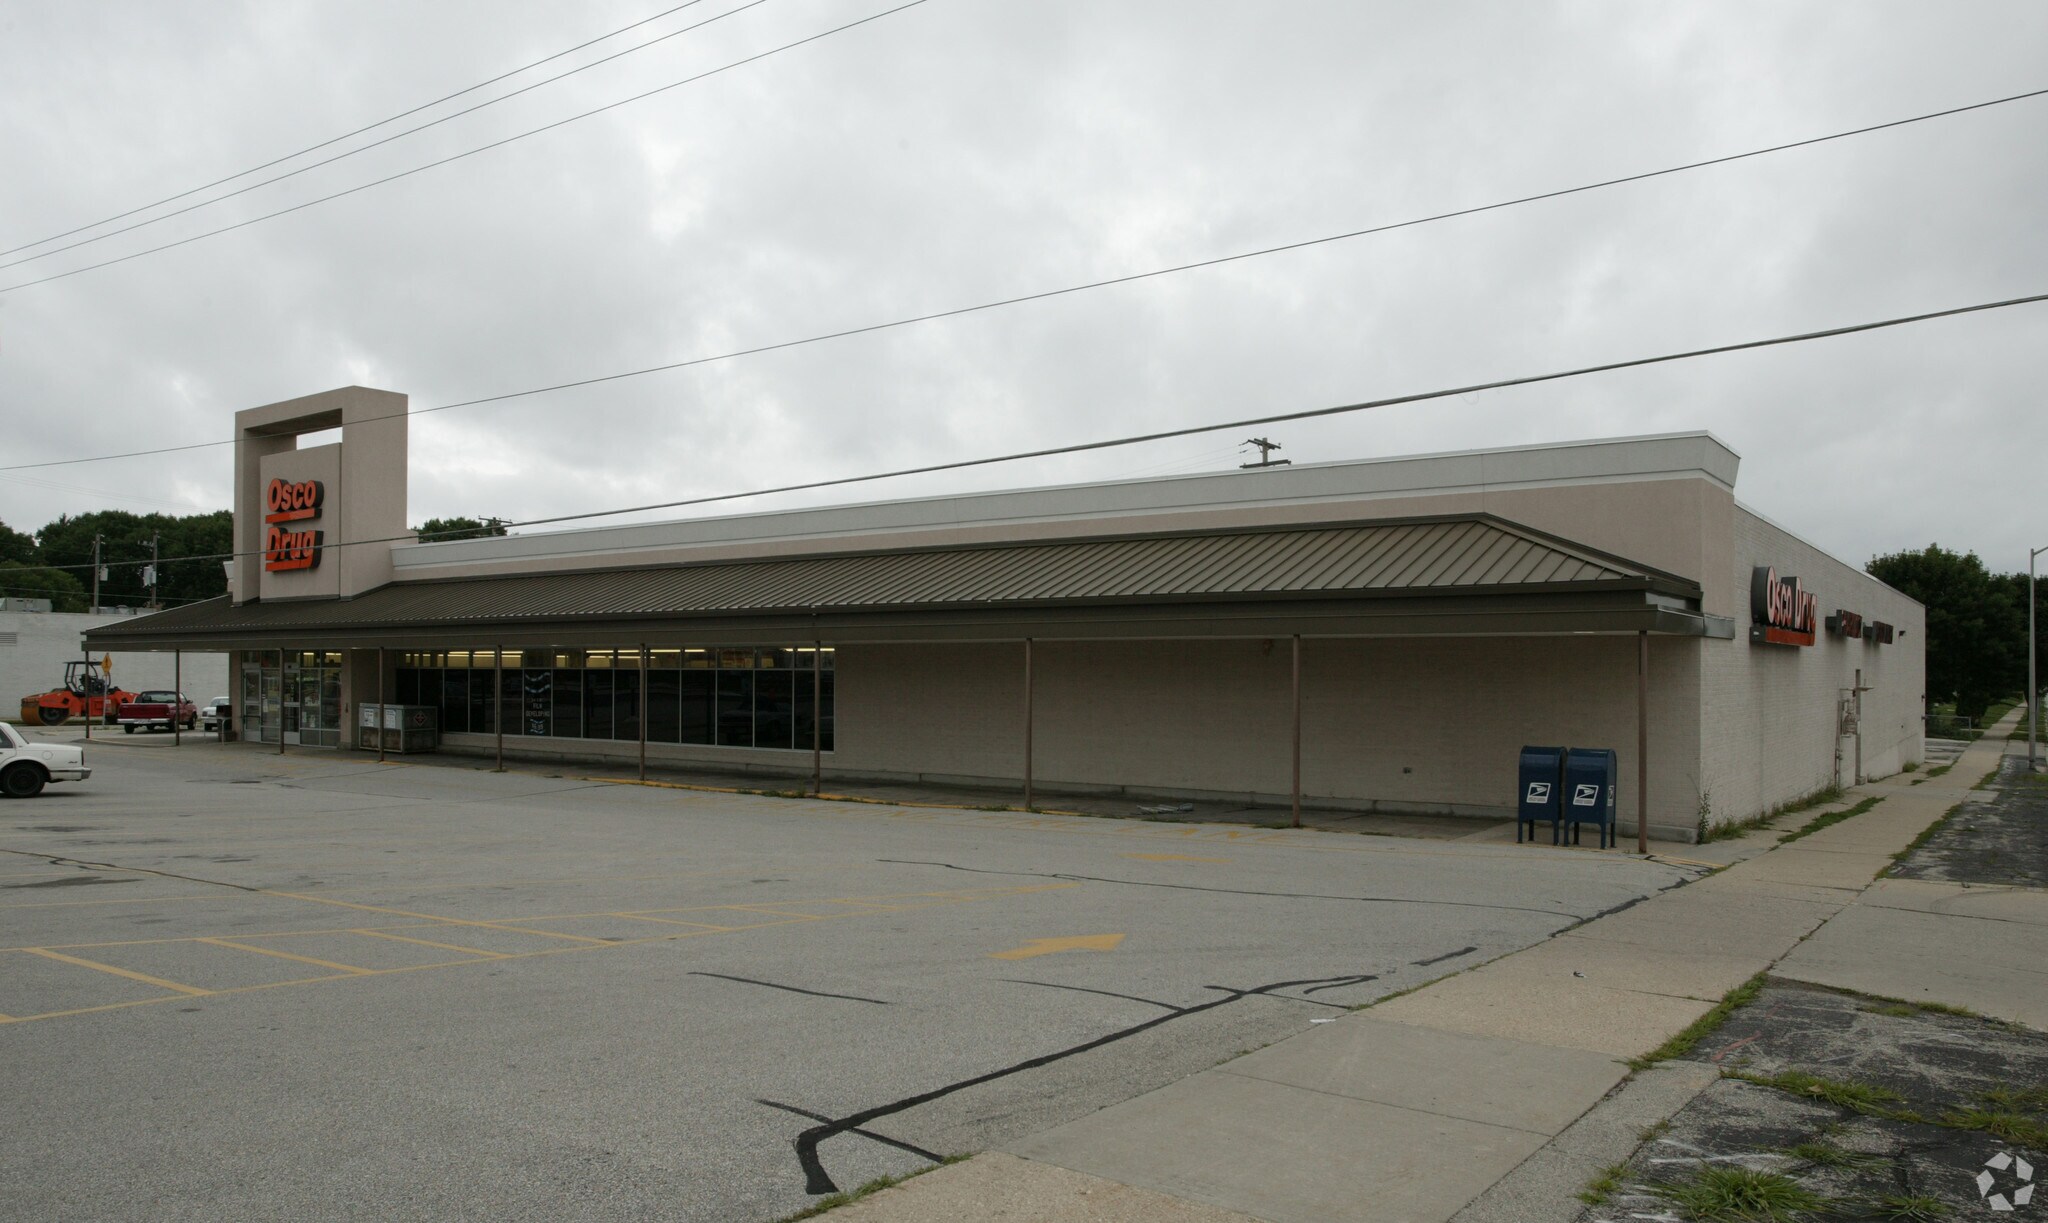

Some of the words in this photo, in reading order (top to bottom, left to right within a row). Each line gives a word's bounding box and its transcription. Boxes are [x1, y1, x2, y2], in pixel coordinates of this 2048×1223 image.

[267, 478, 317, 512] Osco
[265, 526, 316, 572] Drug
[1766, 565, 1793, 627] Osco
